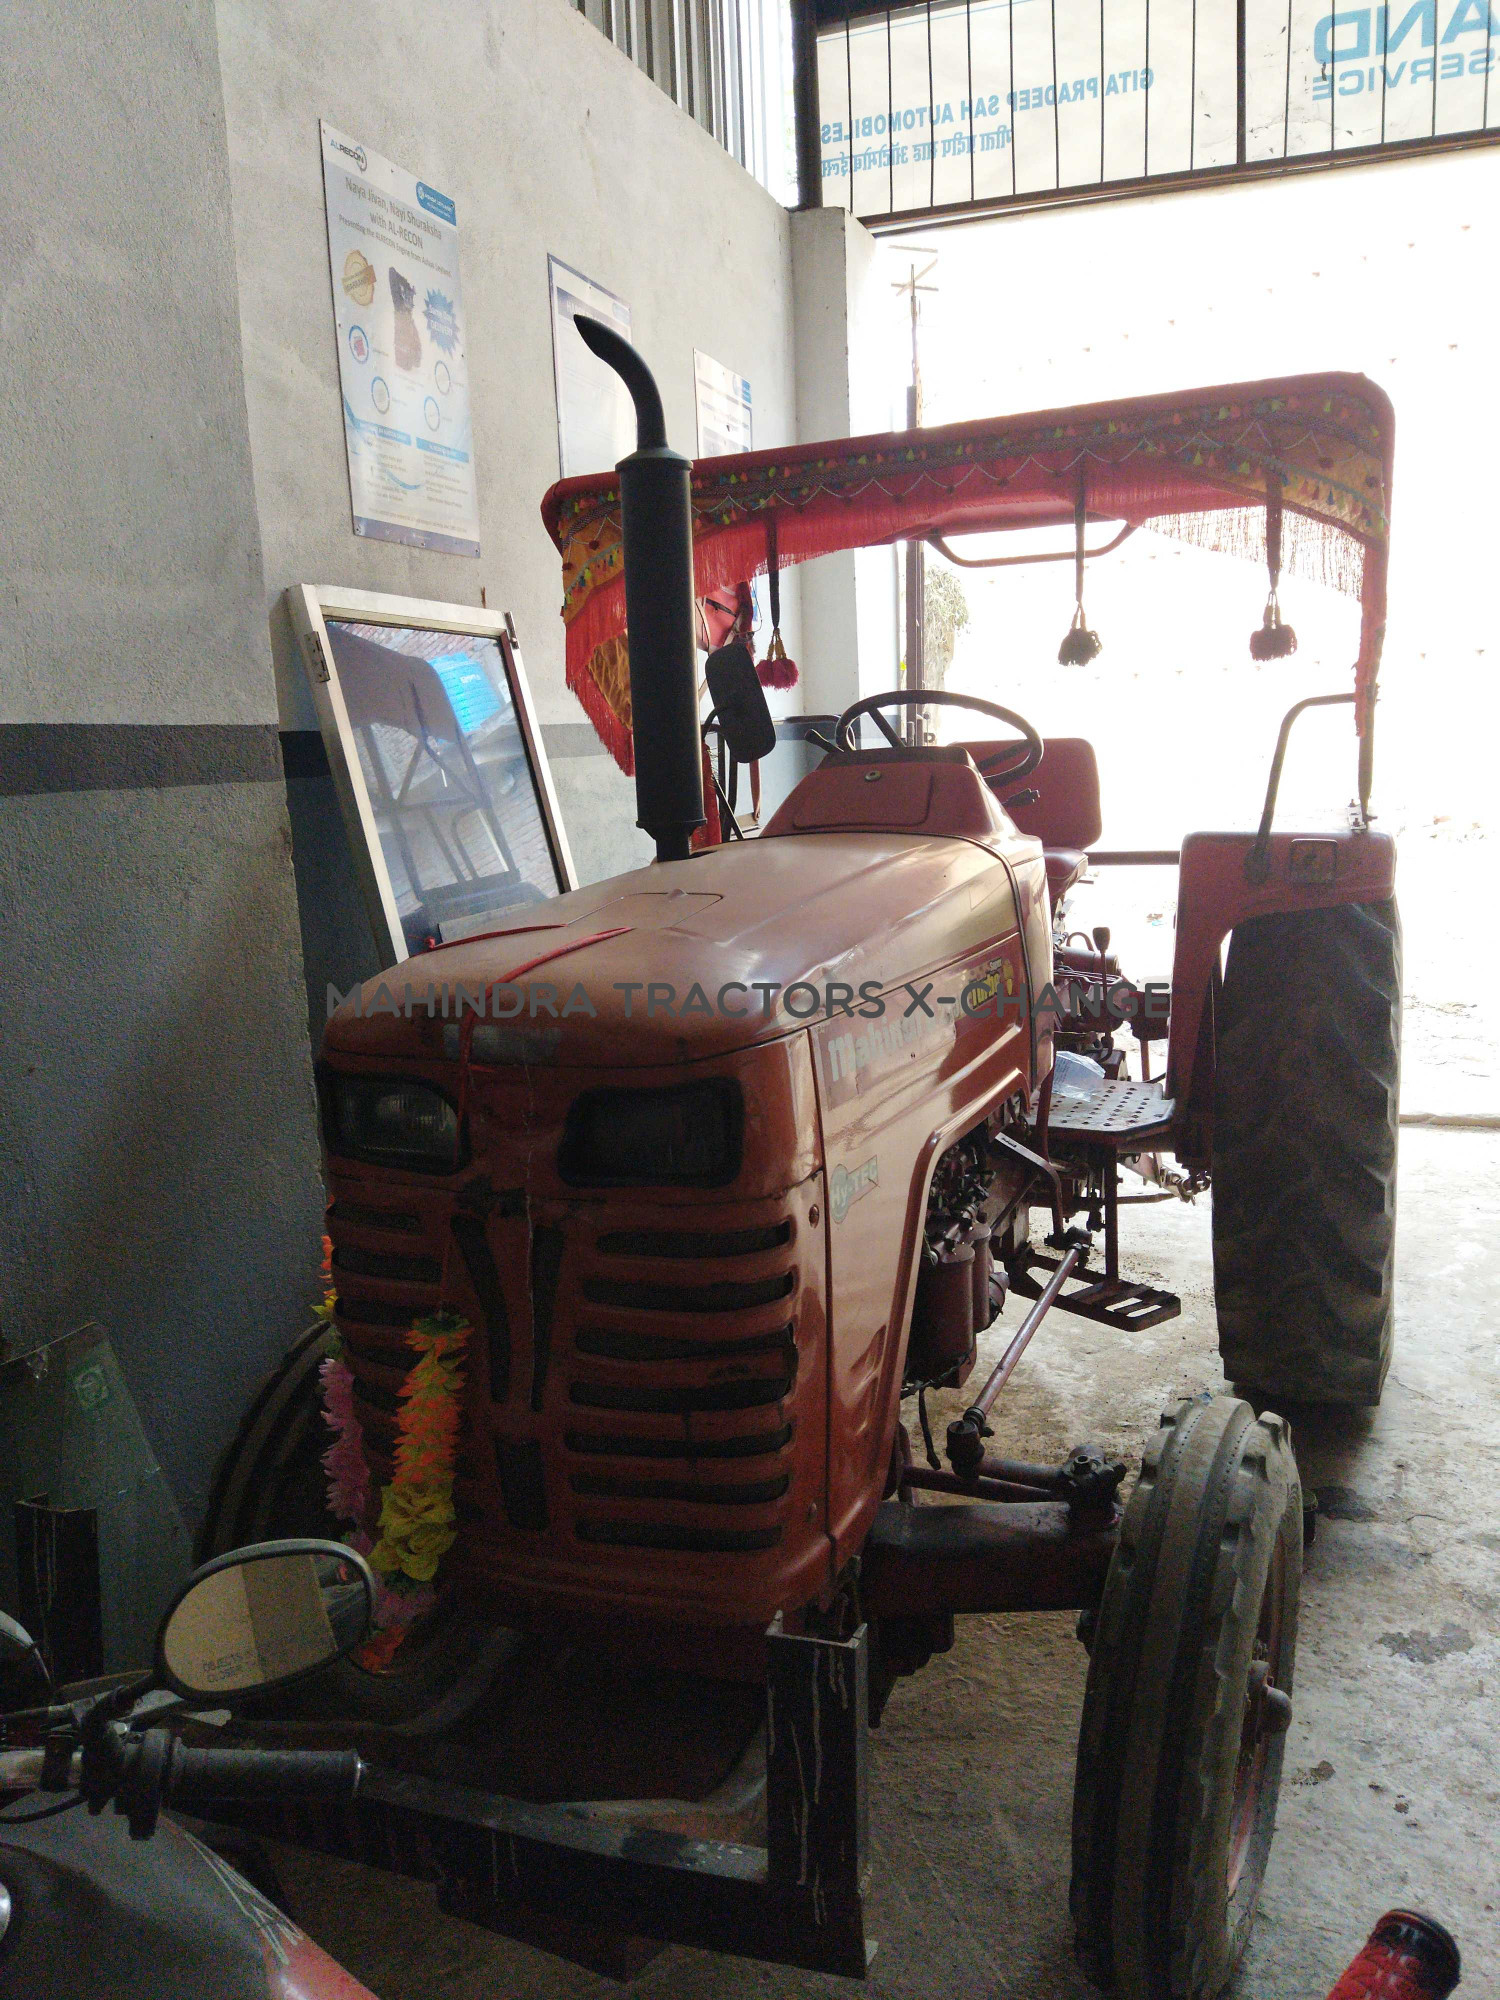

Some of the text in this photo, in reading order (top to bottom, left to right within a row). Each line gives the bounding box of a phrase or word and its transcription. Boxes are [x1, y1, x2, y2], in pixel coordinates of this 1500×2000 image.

[345, 176, 367, 200] Naya
[390, 200, 406, 223] Nayi
[370, 211, 424, 249] with AL-RECON
